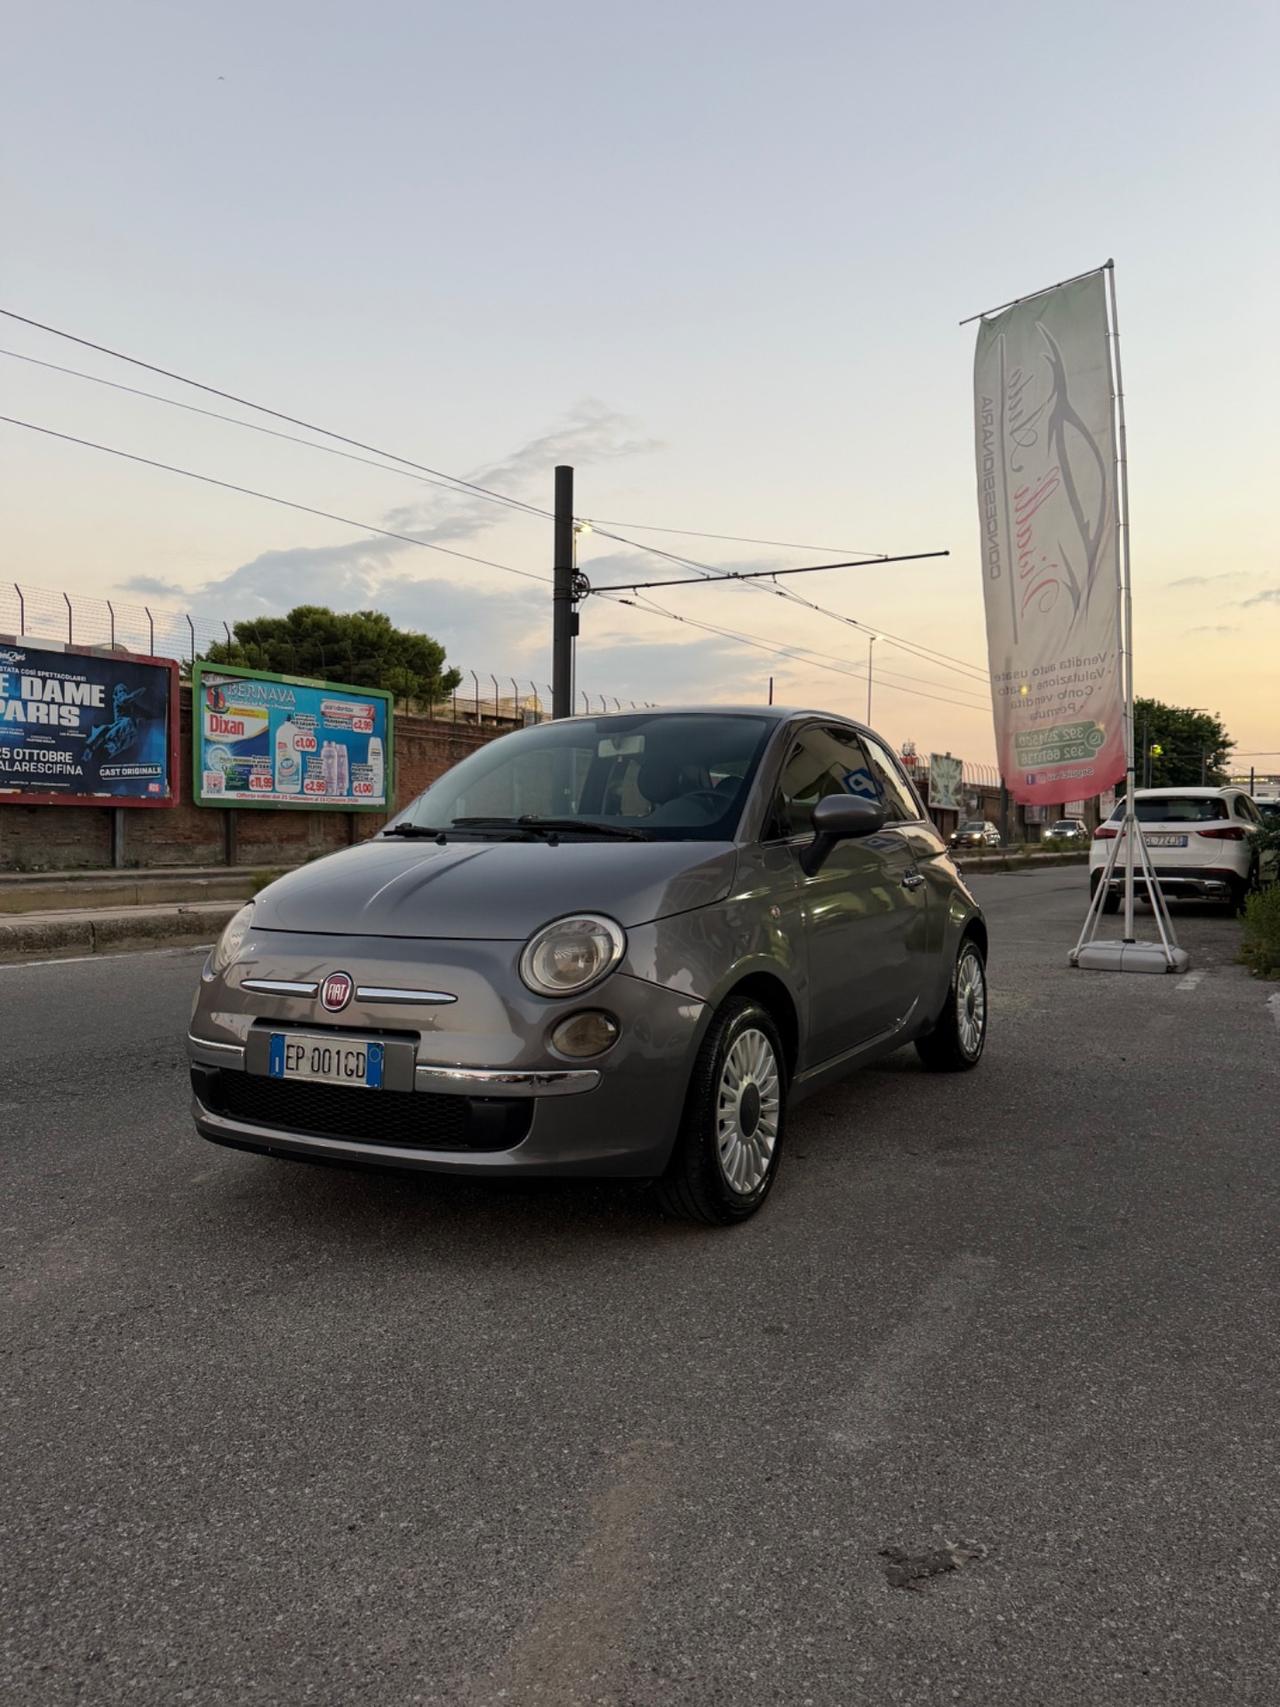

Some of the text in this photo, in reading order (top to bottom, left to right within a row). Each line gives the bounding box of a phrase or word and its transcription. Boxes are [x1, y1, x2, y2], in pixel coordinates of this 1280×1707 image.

[21, 675, 105, 708] DAME
[227, 682, 296, 704] BERNAVA
[210, 714, 245, 736] Dixan
[0, 747, 73, 763] 5 OTTOBRE
[99, 766, 162, 777] CAST ORIGINALE
[328, 984, 346, 1000] FIAT
[285, 1044, 306, 1071] EP
[311, 1047, 366, 1078] 001GD
